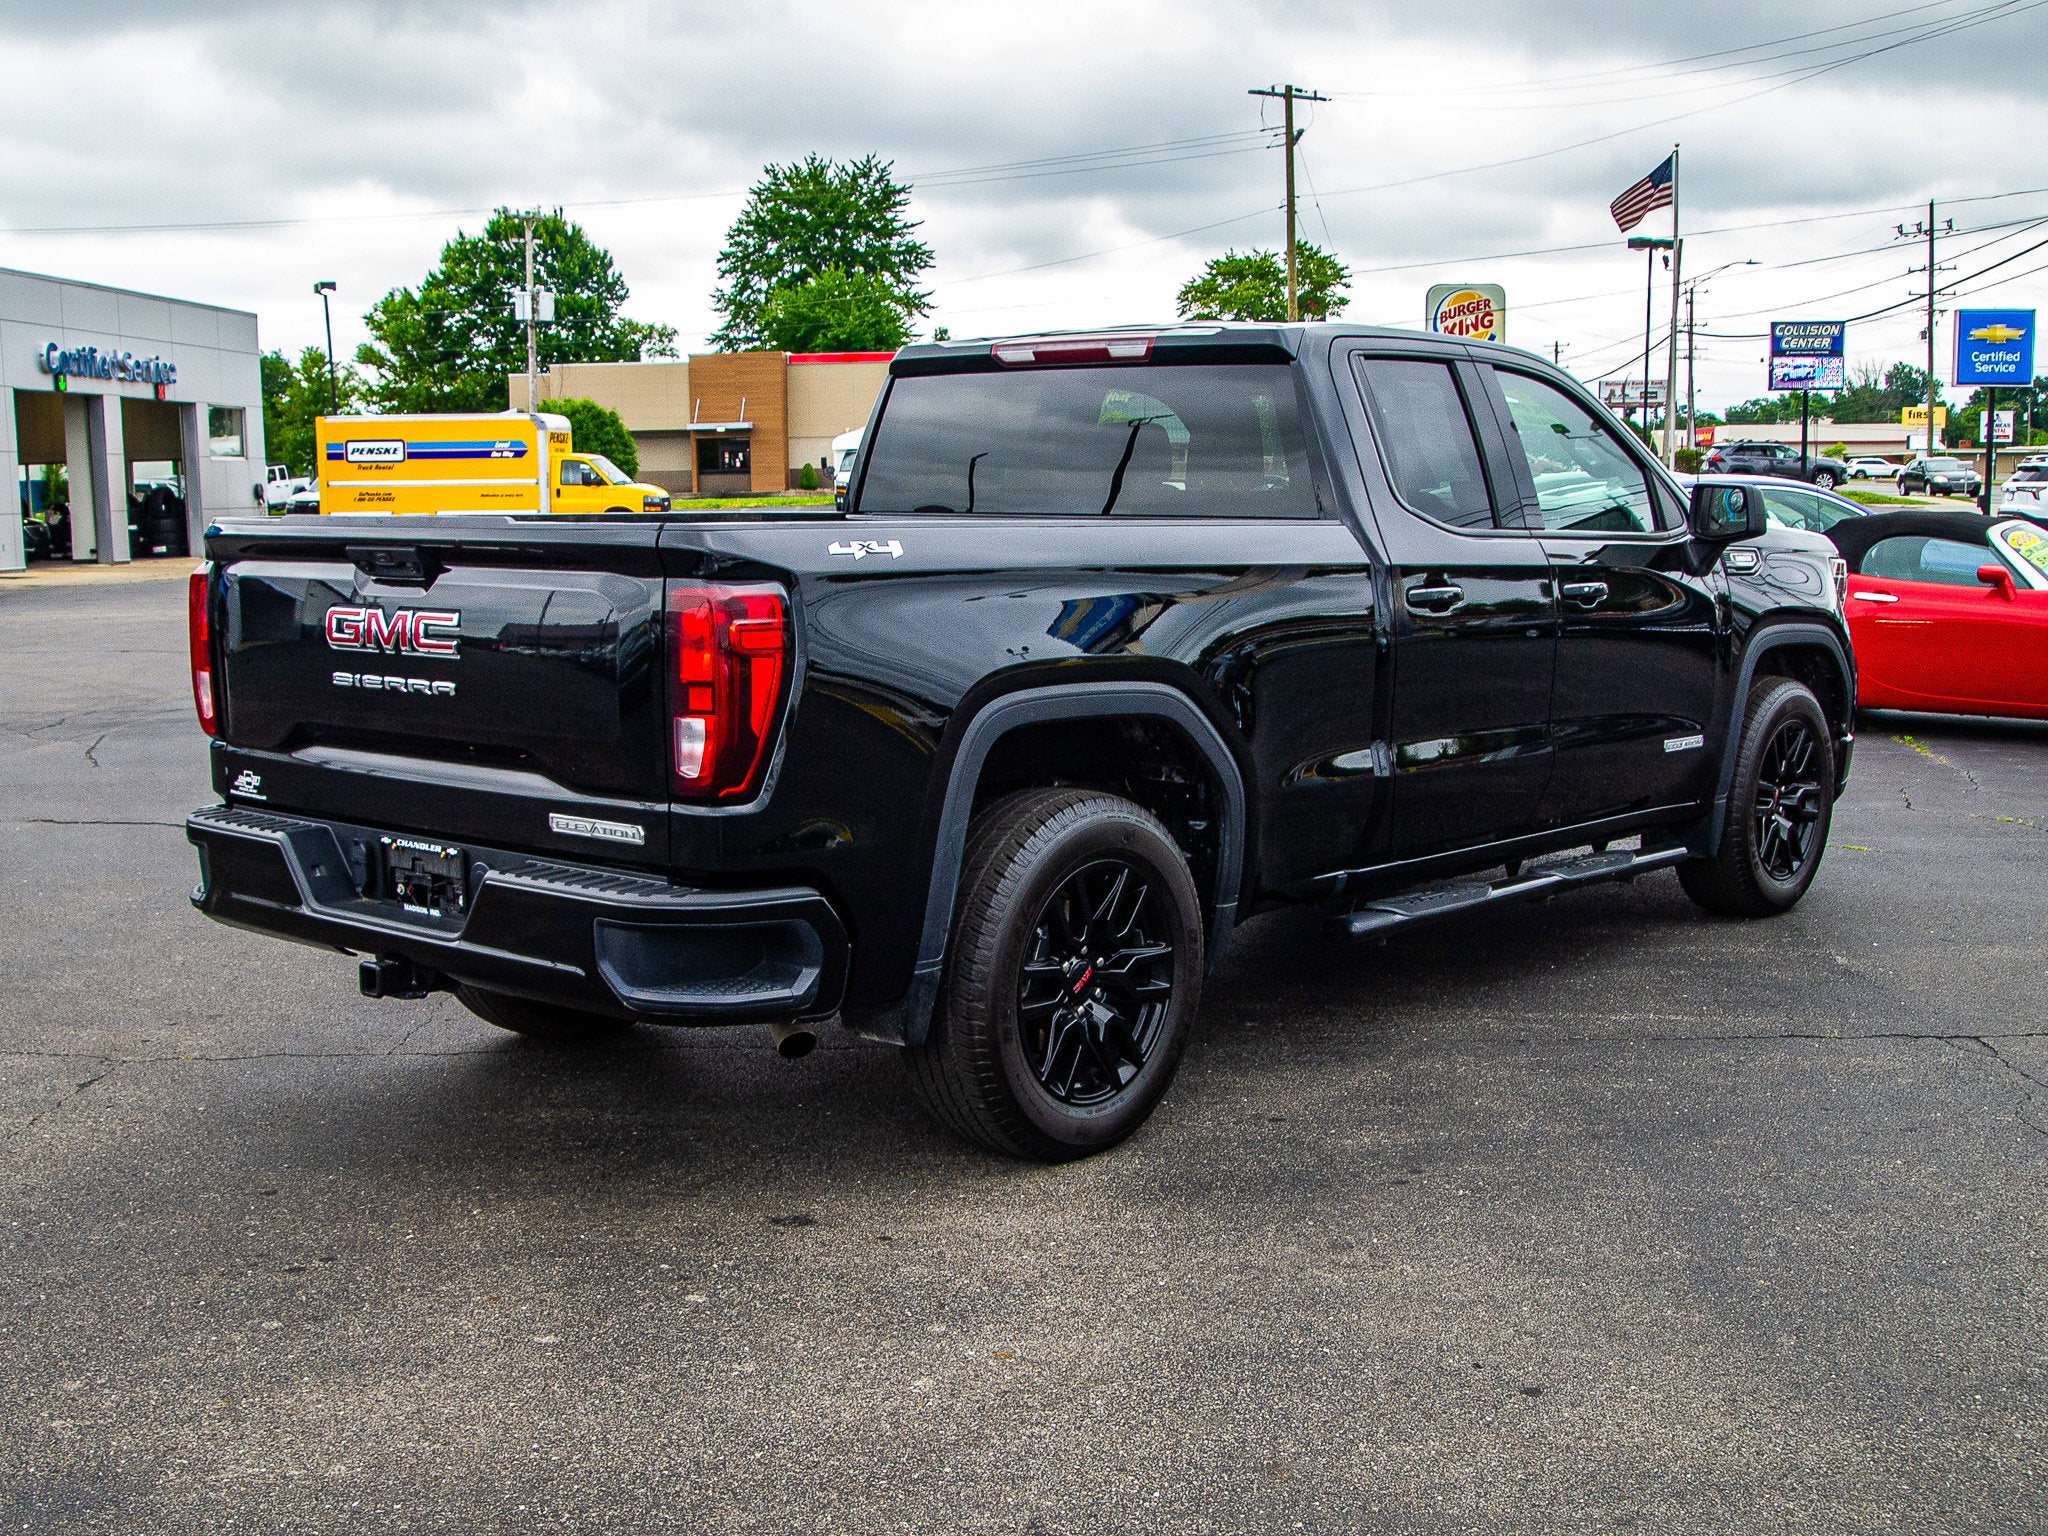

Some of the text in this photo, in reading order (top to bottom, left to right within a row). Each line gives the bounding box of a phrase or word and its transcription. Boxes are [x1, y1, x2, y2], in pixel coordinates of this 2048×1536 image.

[1440, 298, 1492, 324] BURGER
[1443, 312, 1494, 336] KING
[1775, 324, 1840, 336] COLLISION
[1781, 336, 1831, 349] CENTER
[45, 342, 177, 384] Certified Service
[1971, 350, 2021, 362] Certified
[1974, 361, 2016, 373] Service
[494, 440, 511, 449] Local
[549, 431, 569, 444] PENSKE
[350, 447, 400, 455] PENSKE
[325, 606, 461, 658] GMC
[332, 671, 457, 697] SIERRA
[555, 820, 637, 840] ELEVATION
[396, 838, 442, 853] CHANDLER
